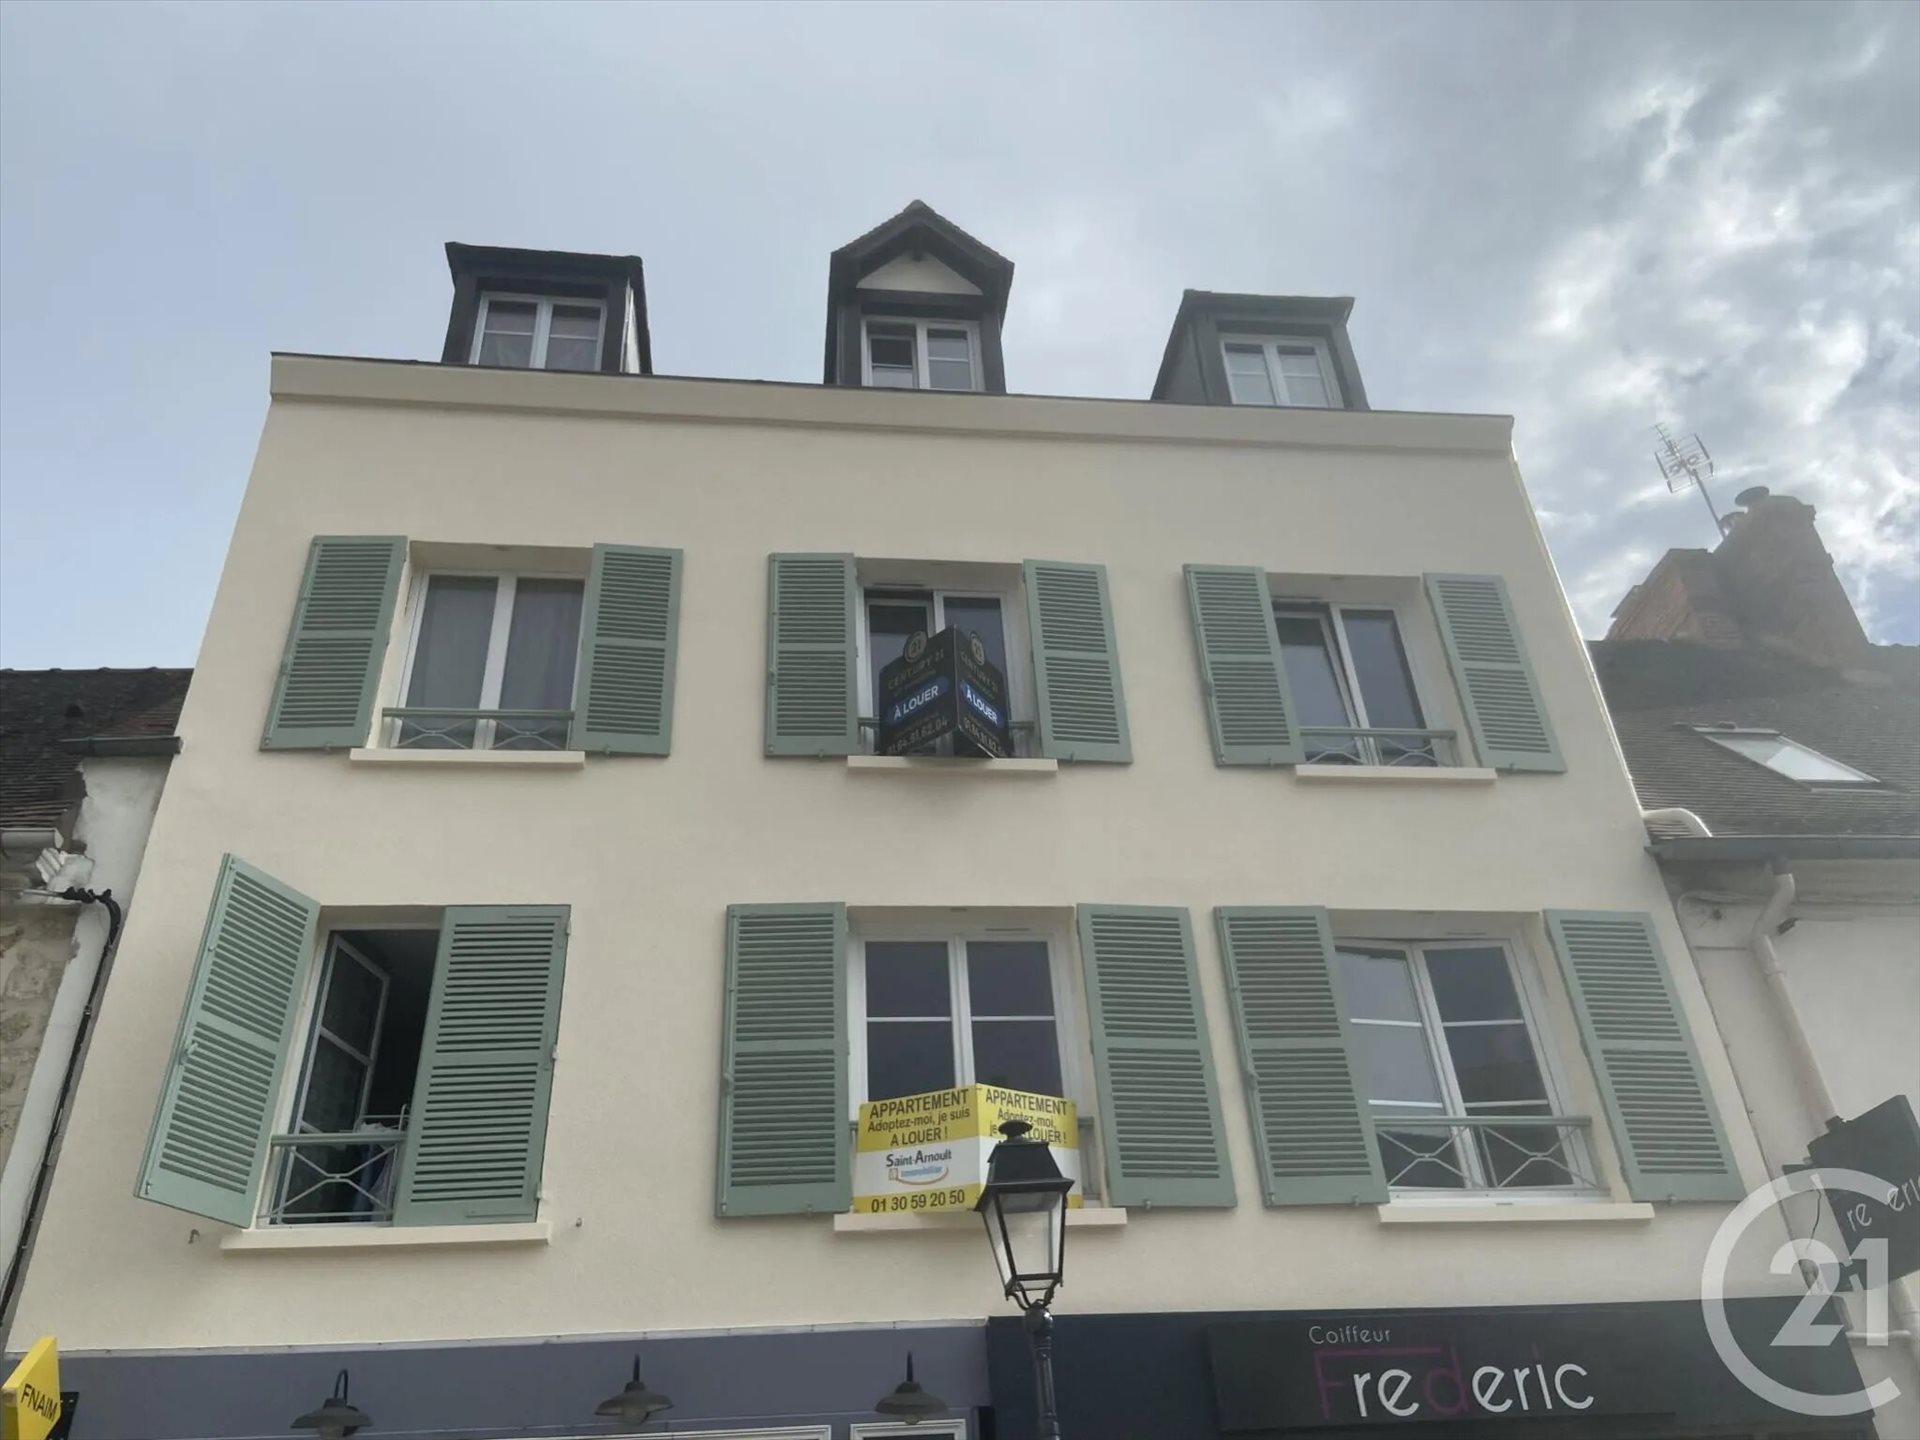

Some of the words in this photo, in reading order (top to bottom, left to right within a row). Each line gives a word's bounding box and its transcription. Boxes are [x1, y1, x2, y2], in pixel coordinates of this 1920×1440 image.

[903, 685, 939, 714] LOUER
[973, 694, 998, 725] LOUER
[869, 1089, 969, 1119] APPARTEMENT
[985, 1088, 1067, 1116] APPARTEMENT
[867, 1112, 936, 1133] Adoptez-moi,
[938, 1112, 947, 1126] je
[950, 1108, 970, 1121] suis
[890, 1133, 899, 1147] A
[902, 1127, 942, 1145] LOUER
[944, 1126, 948, 1139] !
[871, 1198, 886, 1213] 01
[891, 1196, 907, 1211] 30
[910, 1193, 927, 1209] 59
[930, 1191, 946, 1207] 20
[949, 1189, 965, 1205] 50
[1308, 1324, 1391, 1345] Coiffeur
[20, 1383, 58, 1423] FNAIM
